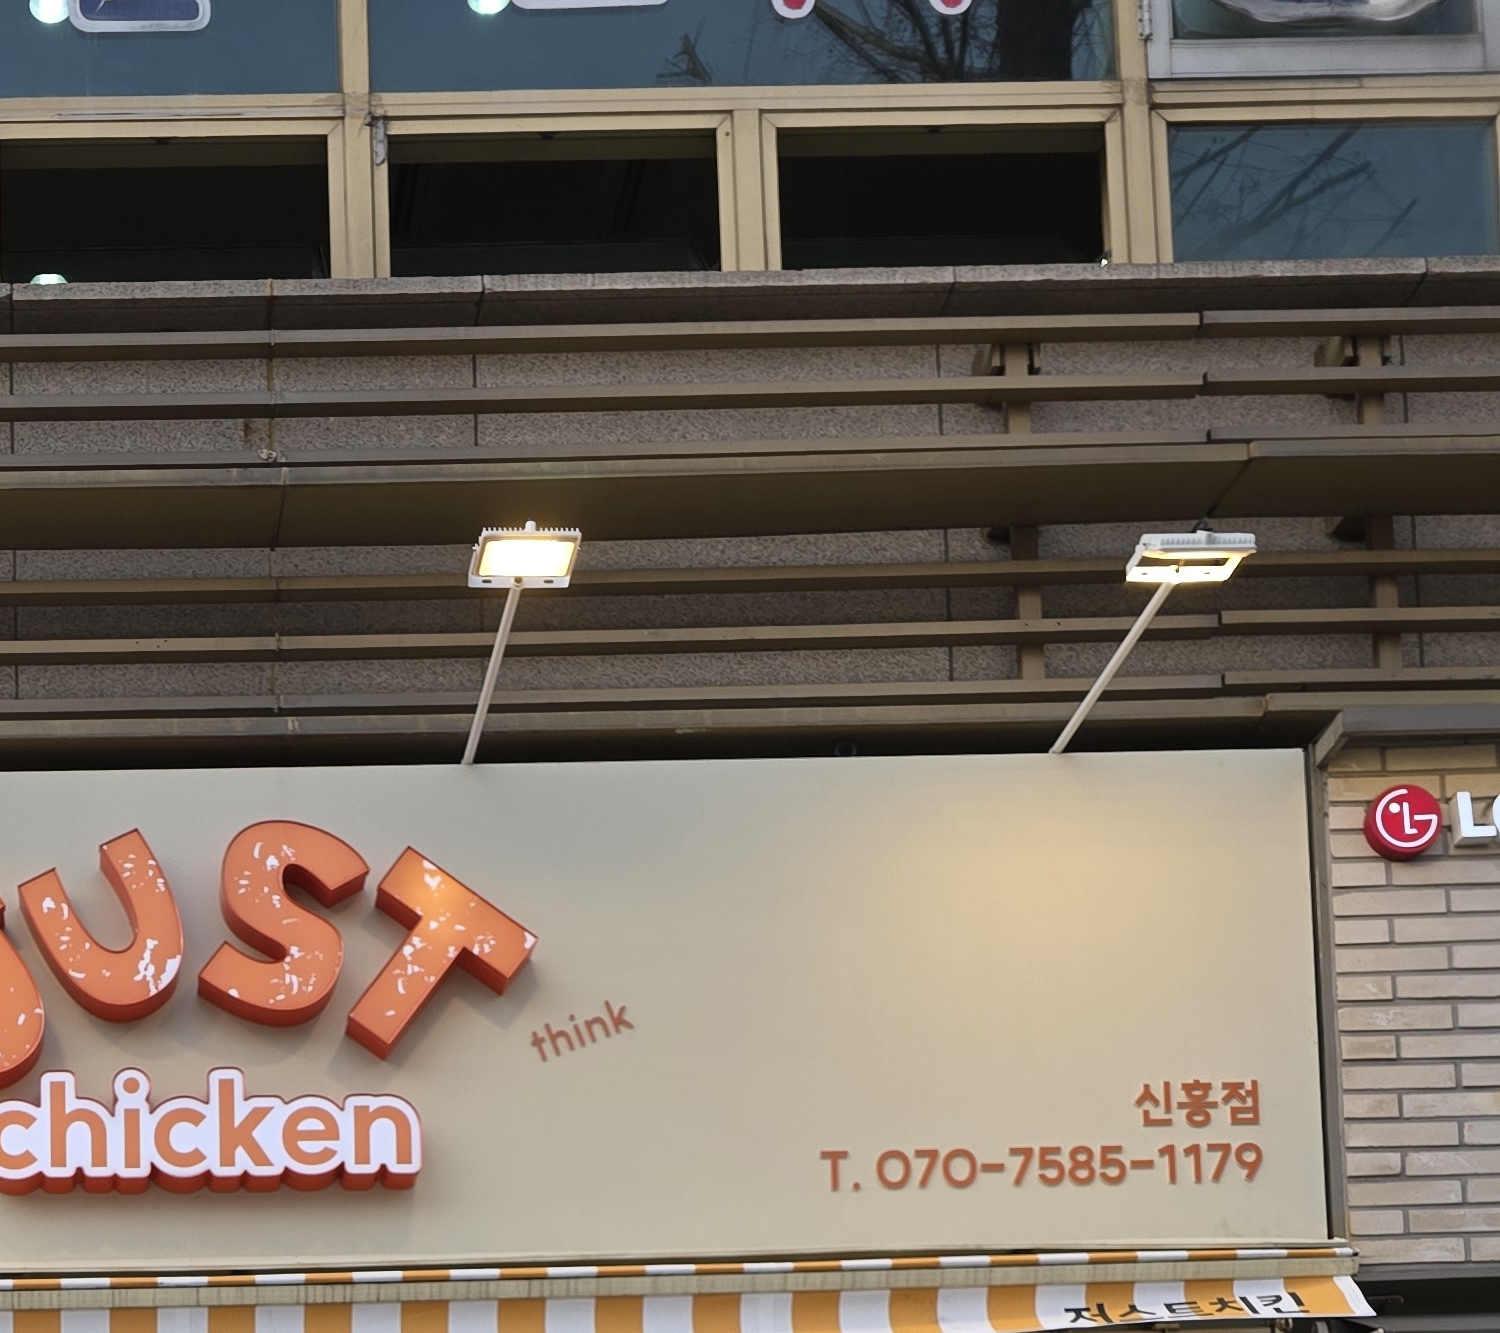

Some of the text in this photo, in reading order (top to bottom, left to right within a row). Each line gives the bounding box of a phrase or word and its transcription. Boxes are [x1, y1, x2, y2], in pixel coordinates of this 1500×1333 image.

[1448, 791, 1500, 848] L
[529, 999, 635, 1062] think
[1134, 1078, 1262, 1129] 신흥점
[820, 1142, 1264, 1191] T. 070-7585-1179
[1064, 1291, 1310, 1325] 저스트치킨
